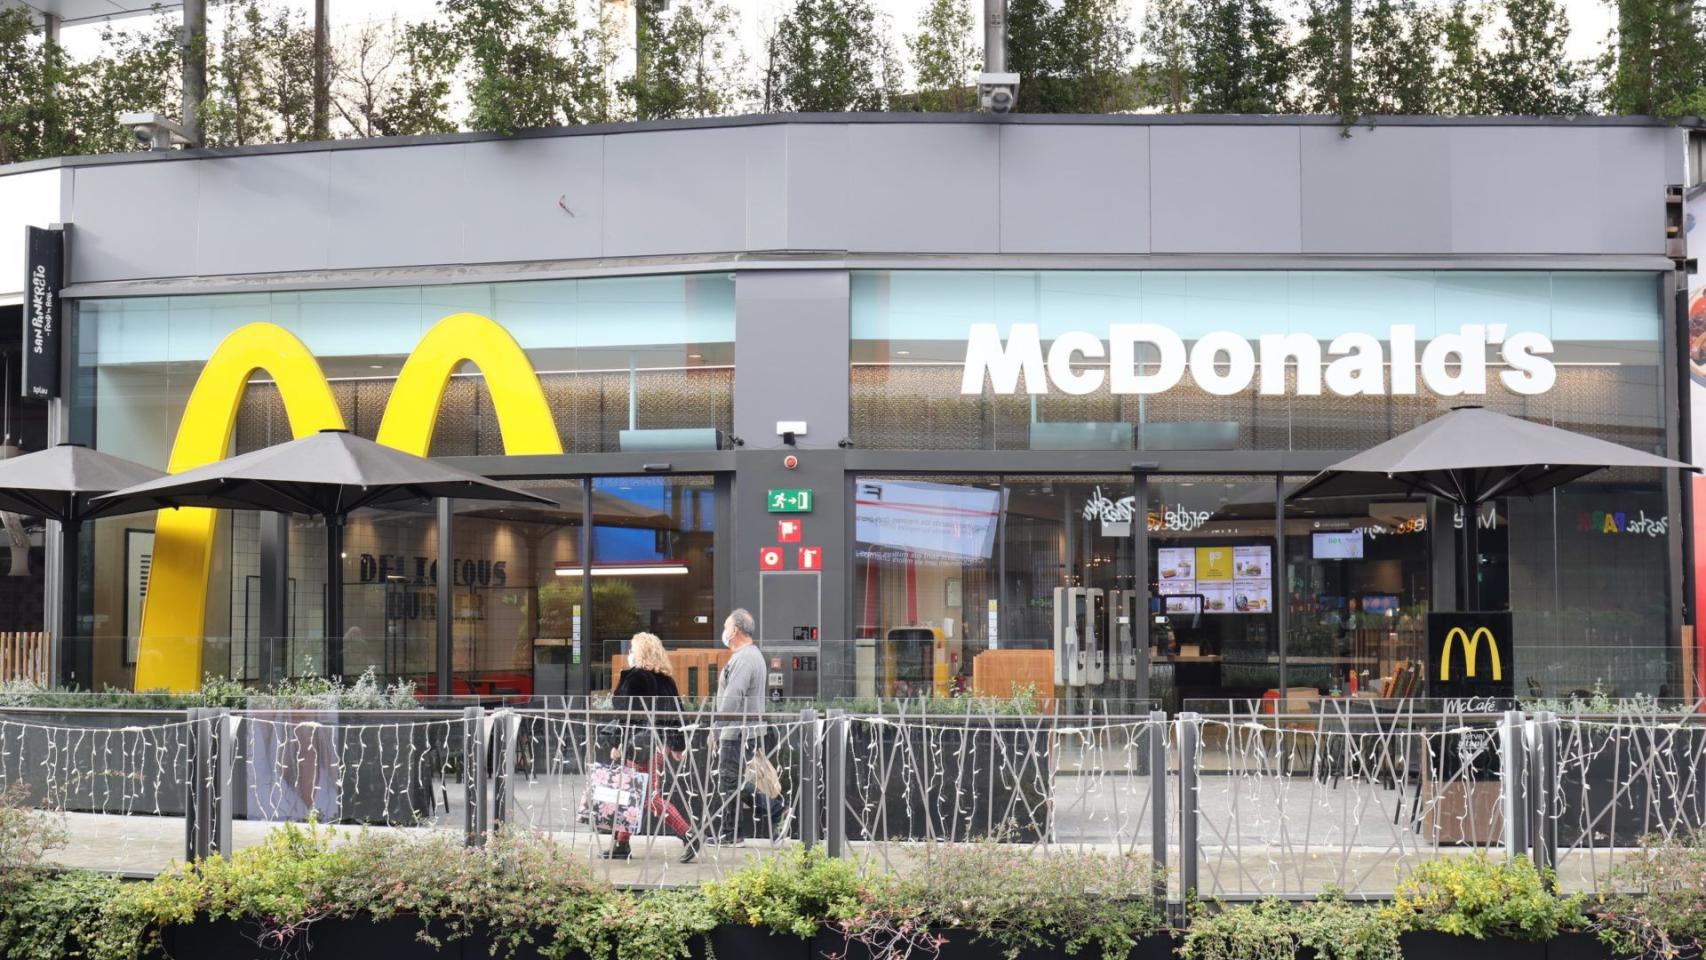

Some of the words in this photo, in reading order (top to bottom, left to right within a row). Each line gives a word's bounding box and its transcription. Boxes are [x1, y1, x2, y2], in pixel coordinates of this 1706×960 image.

[34, 328, 43, 354] SAN
[961, 323, 1556, 396] McDonald's
[1446, 696, 1496, 713] McCafé
